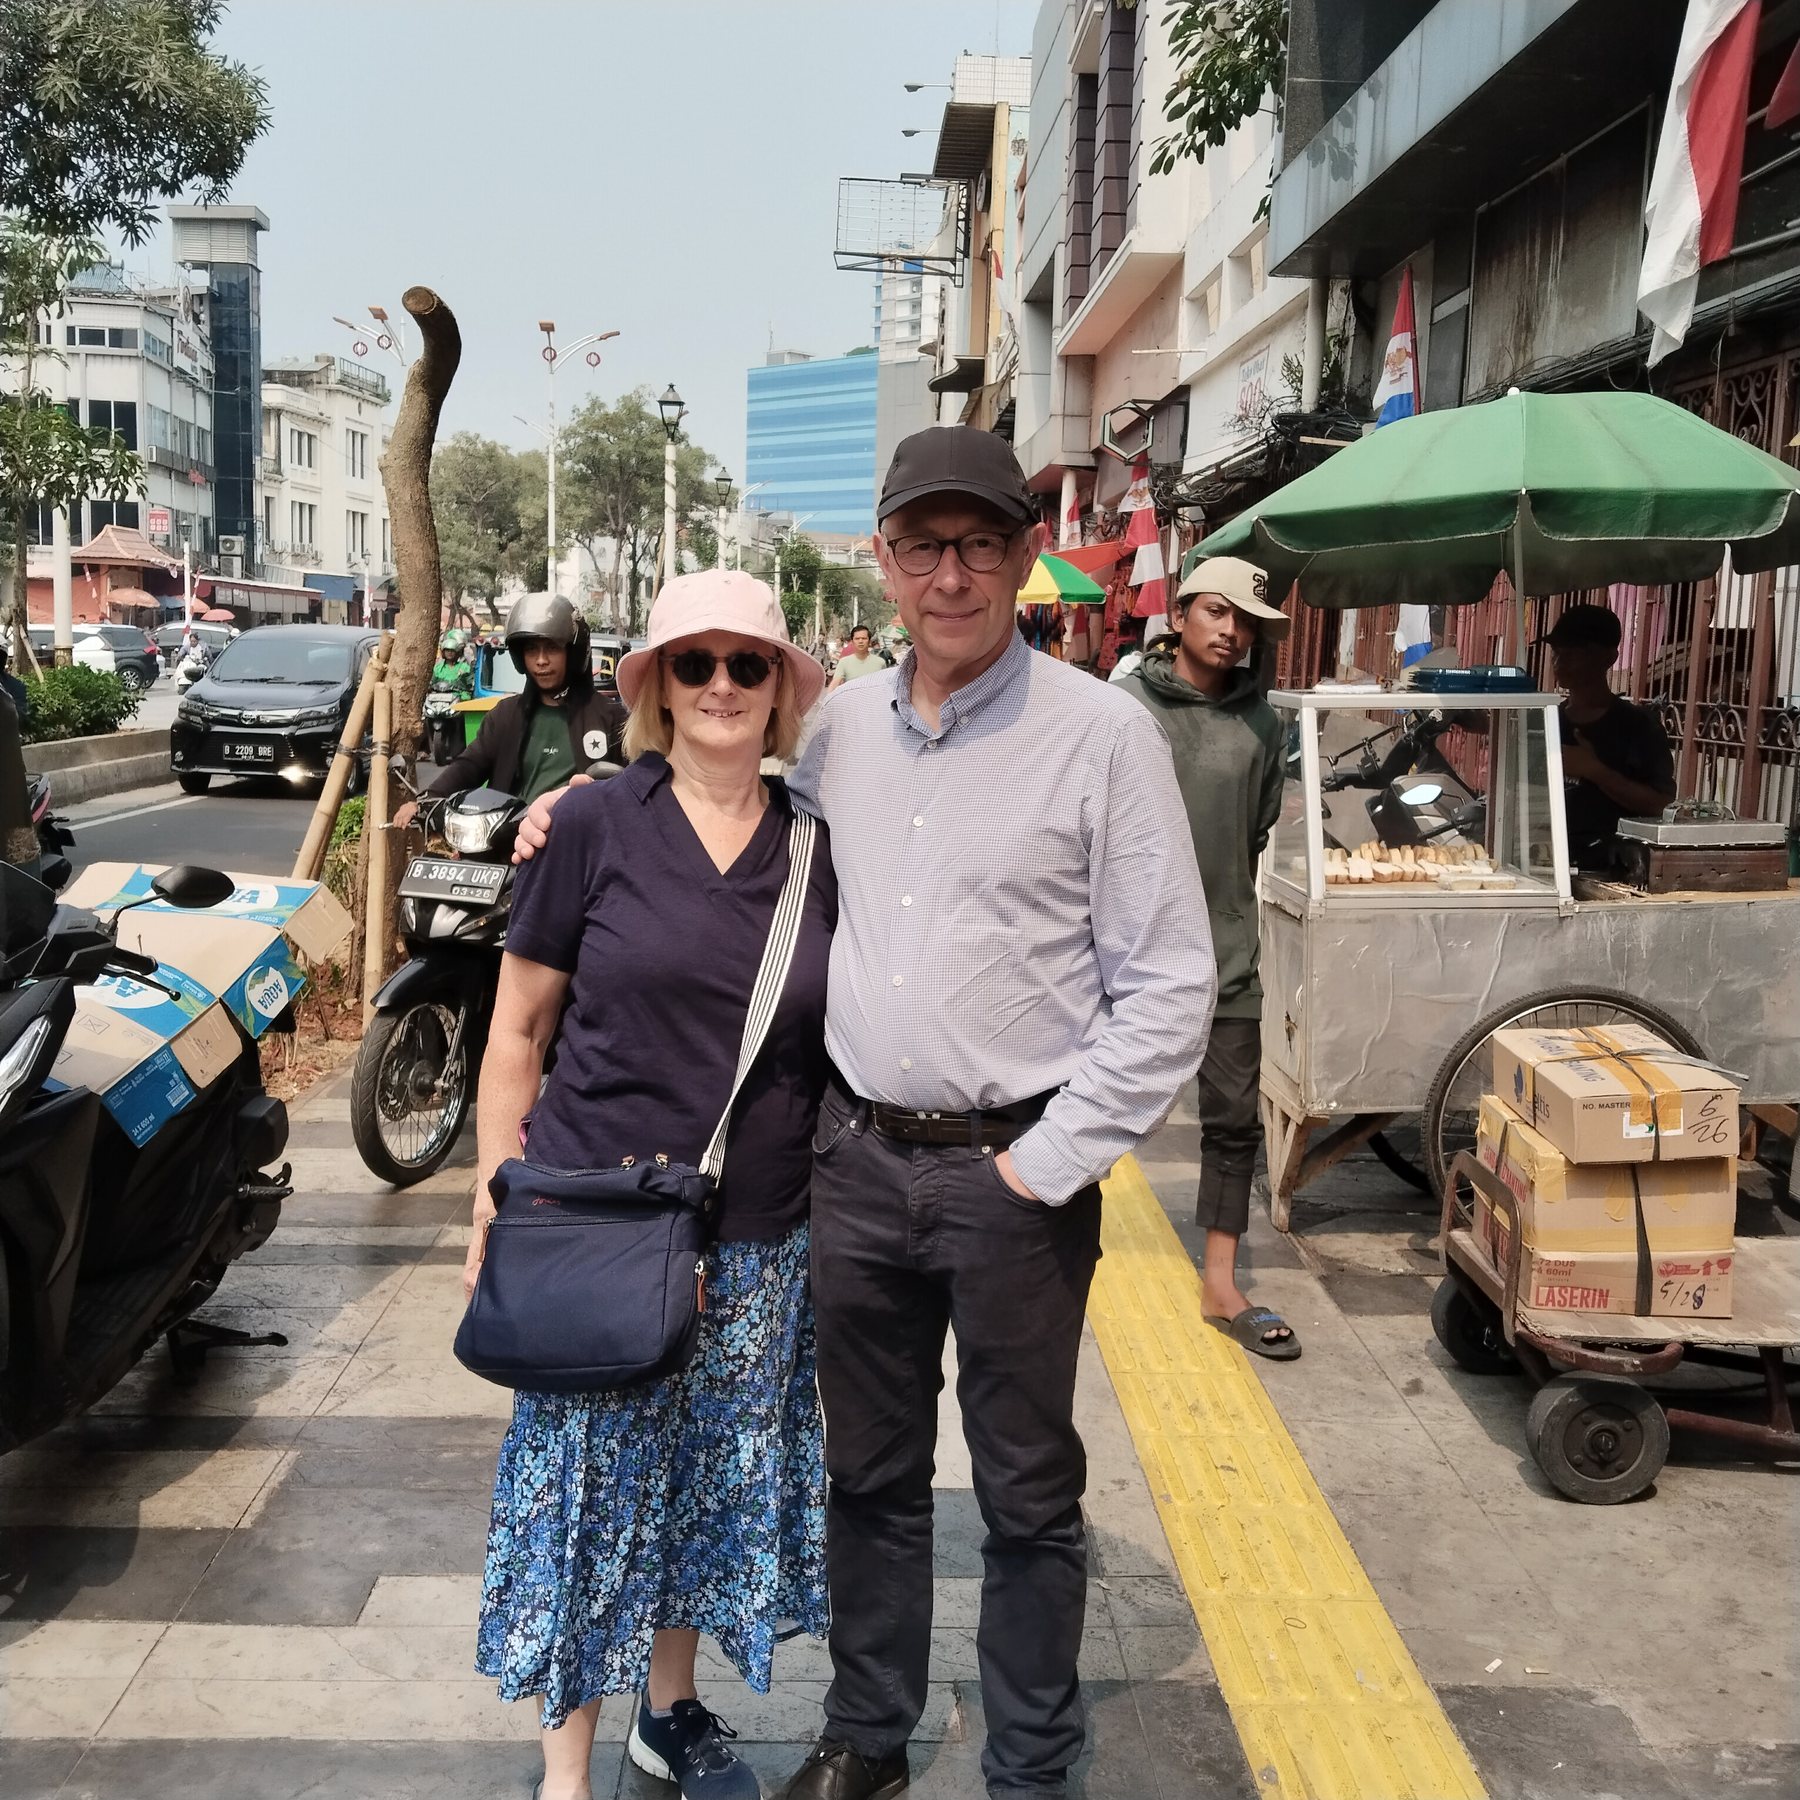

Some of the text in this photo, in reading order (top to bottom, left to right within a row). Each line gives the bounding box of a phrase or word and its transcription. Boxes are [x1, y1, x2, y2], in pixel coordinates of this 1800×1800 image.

[224, 745, 230, 755] B
[235, 745, 254, 756] 2209
[471, 869, 500, 885] UKP
[257, 979, 283, 1010] AQUA
[1582, 1103, 1597, 1111] NO.
[1598, 1101, 1631, 1110] MASTER
[1539, 1257, 1577, 1268] 72 DUS
[1546, 1268, 1572, 1277] 60ml
[1535, 1286, 1610, 1308] LASERIN
